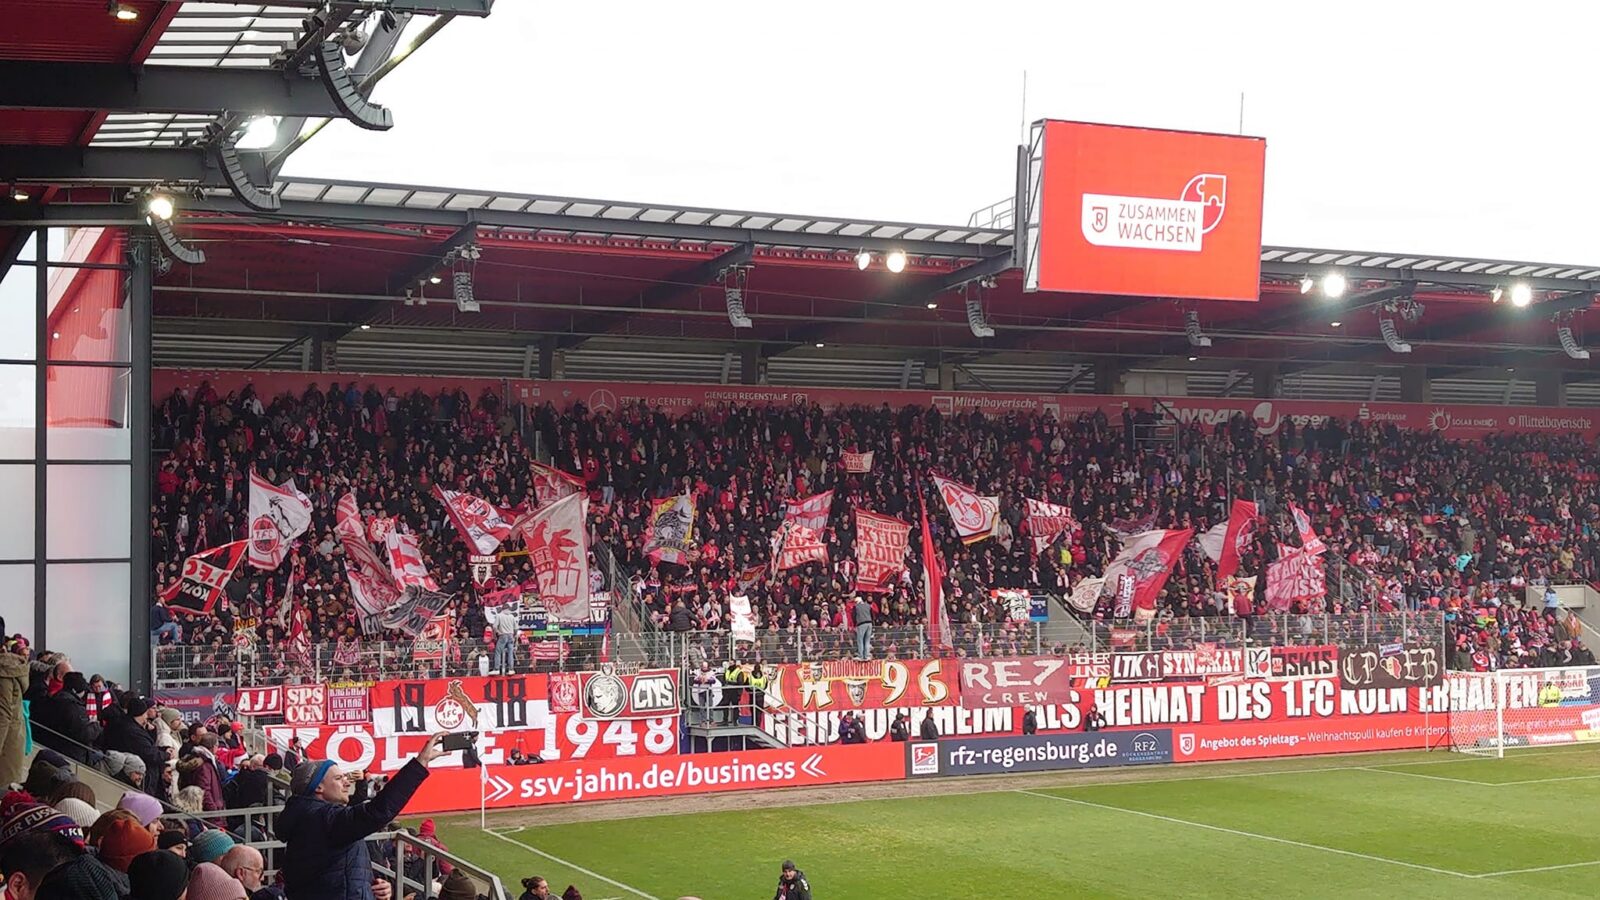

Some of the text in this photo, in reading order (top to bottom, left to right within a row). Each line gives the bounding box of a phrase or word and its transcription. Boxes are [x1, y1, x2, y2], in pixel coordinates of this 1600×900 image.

[1119, 203, 1197, 223] ZUSAMMEN
[1118, 223, 1196, 244] WACHSEN
[954, 397, 1038, 409] Mittelbayerische
[1372, 411, 1407, 422] Sparkasse
[1113, 654, 1146, 678] LTK
[287, 687, 324, 706] SPS
[983, 691, 1048, 705] CREW
[1094, 684, 1205, 727] HEIMAT
[1217, 682, 1272, 721] DES
[1419, 675, 1539, 713] ERHALTEN
[540, 713, 675, 760] 1948
[1134, 741, 1156, 751] RFZ
[1200, 735, 1239, 751] Angebot
[1240, 735, 1257, 748] des
[1258, 733, 1300, 749] Spieltags
[1307, 730, 1374, 744] Weihnachtspulli
[1376, 727, 1403, 740] kaufen
[1405, 726, 1413, 737] &
[950, 739, 1118, 768] rfz-regensburg.de
[520, 759, 796, 800] ssv-jahn.de/business
